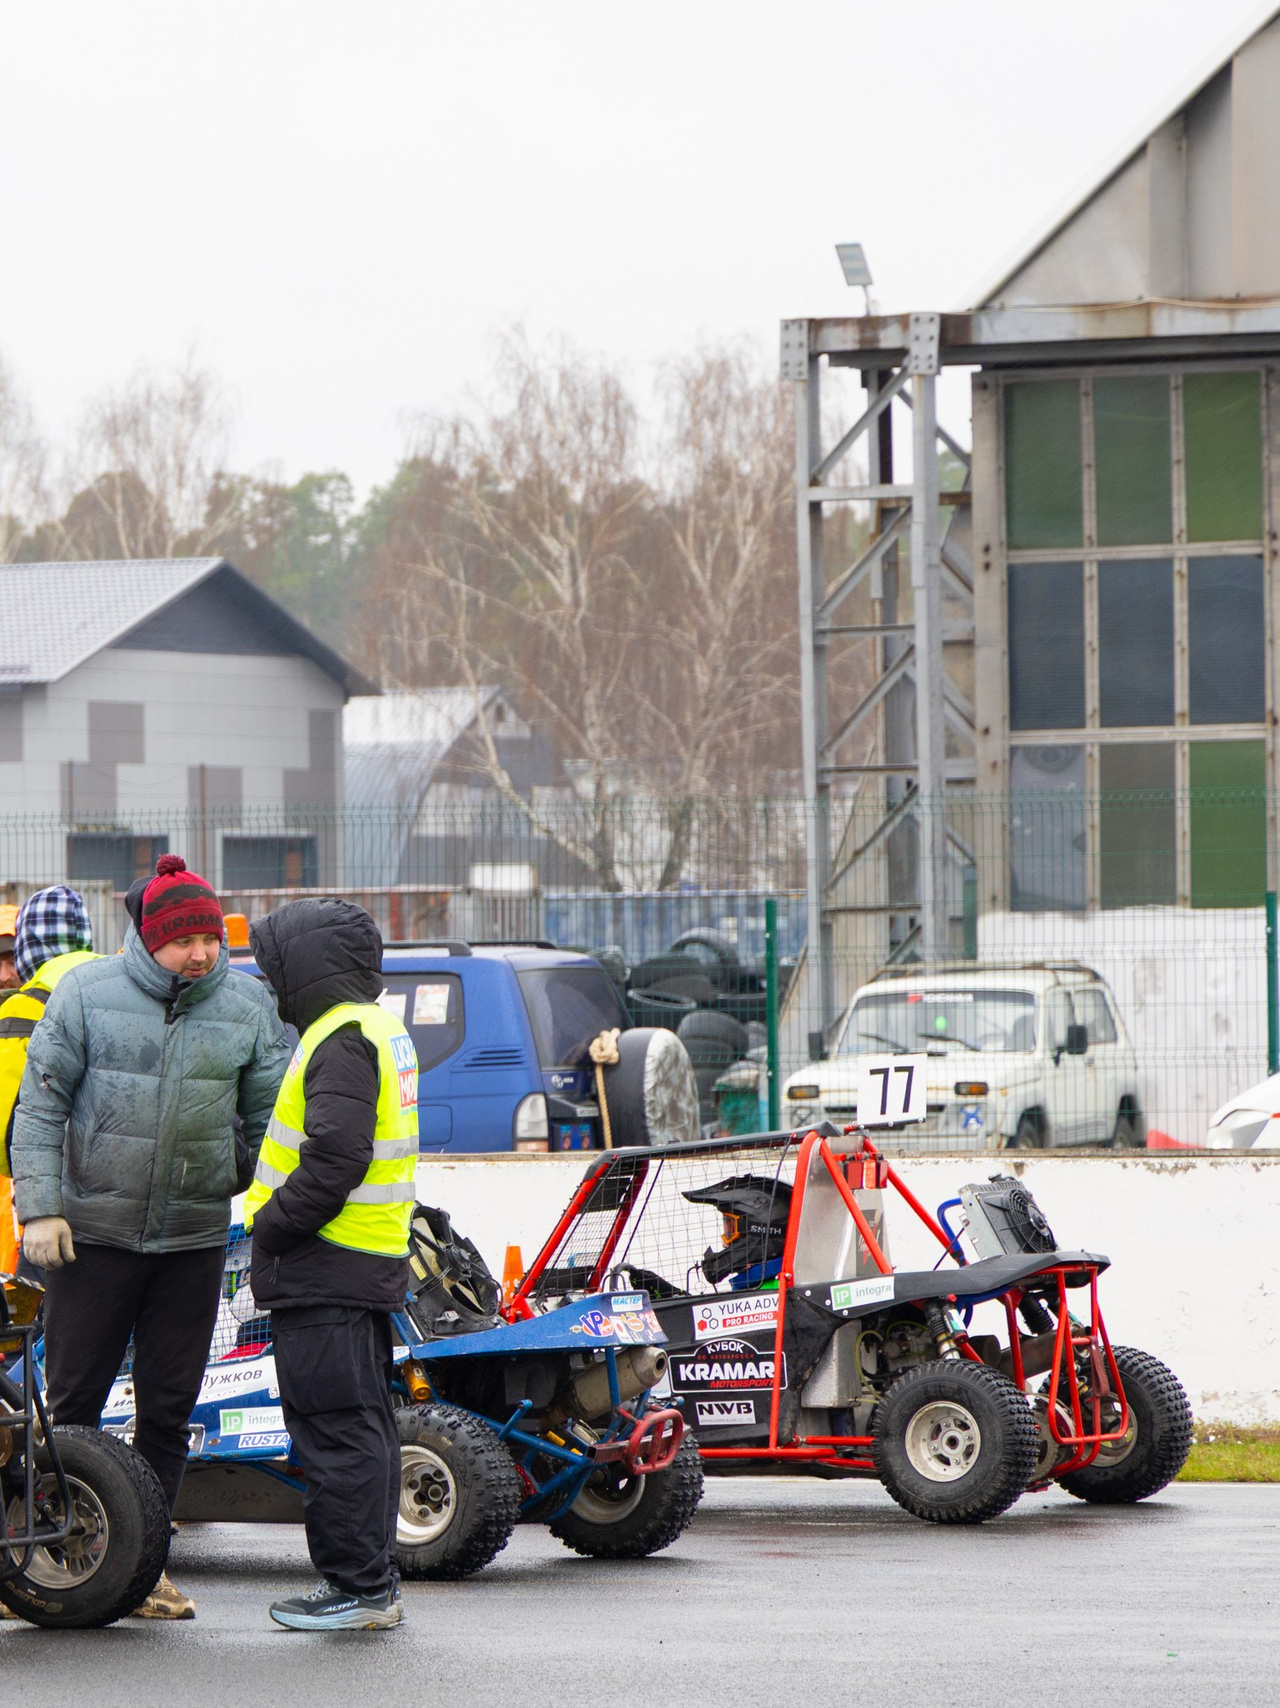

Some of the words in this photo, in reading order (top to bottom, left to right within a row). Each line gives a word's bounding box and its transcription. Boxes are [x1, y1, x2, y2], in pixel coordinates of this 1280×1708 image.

[869, 1065, 915, 1115] 77
[750, 1225, 782, 1235] SMTH
[856, 1284, 892, 1298] integra
[718, 1301, 752, 1316] YUKA
[579, 1310, 604, 1336] VP
[726, 1317, 743, 1327] PRO
[745, 1312, 774, 1324] RACING
[706, 1341, 745, 1354] КУБОК
[679, 1361, 775, 1381] KRAMAR
[697, 1402, 753, 1416] NWB
[248, 1414, 284, 1427] integr
[240, 1434, 289, 1447] RUSTA
